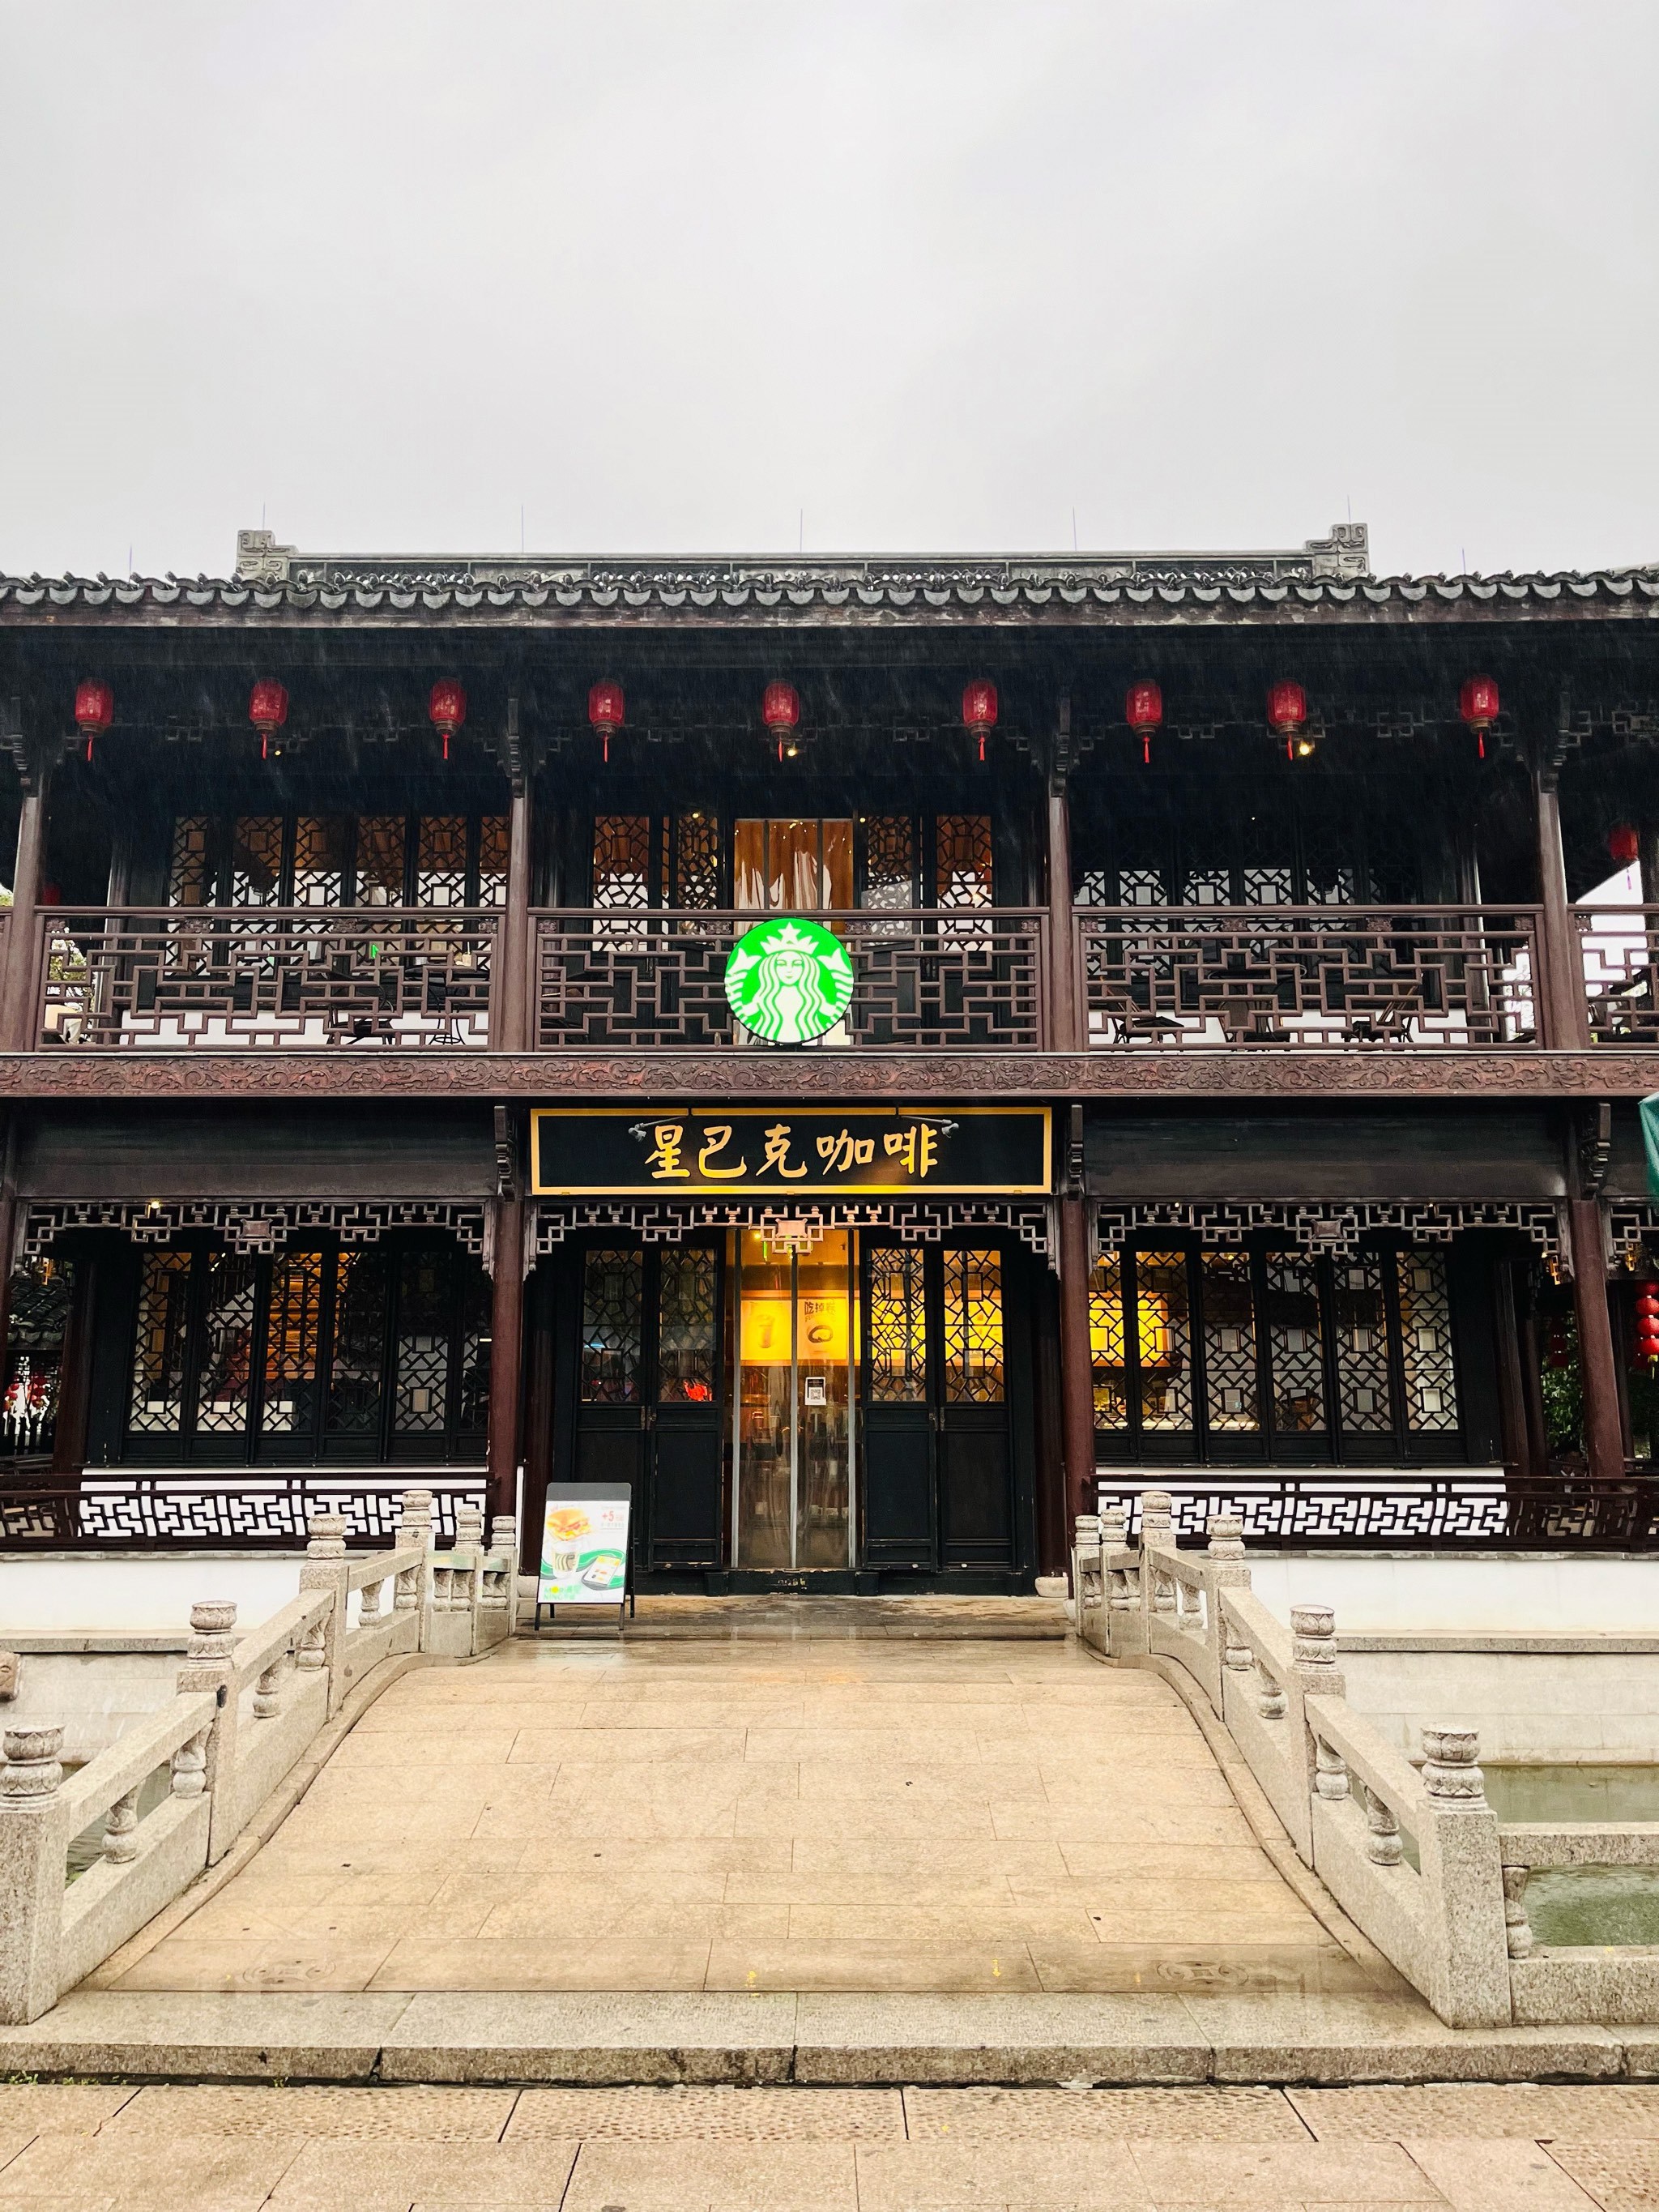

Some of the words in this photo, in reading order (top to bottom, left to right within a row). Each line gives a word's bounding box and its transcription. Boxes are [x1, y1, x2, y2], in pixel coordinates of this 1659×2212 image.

[645, 1123, 938, 1178] 星巴克咖啡
